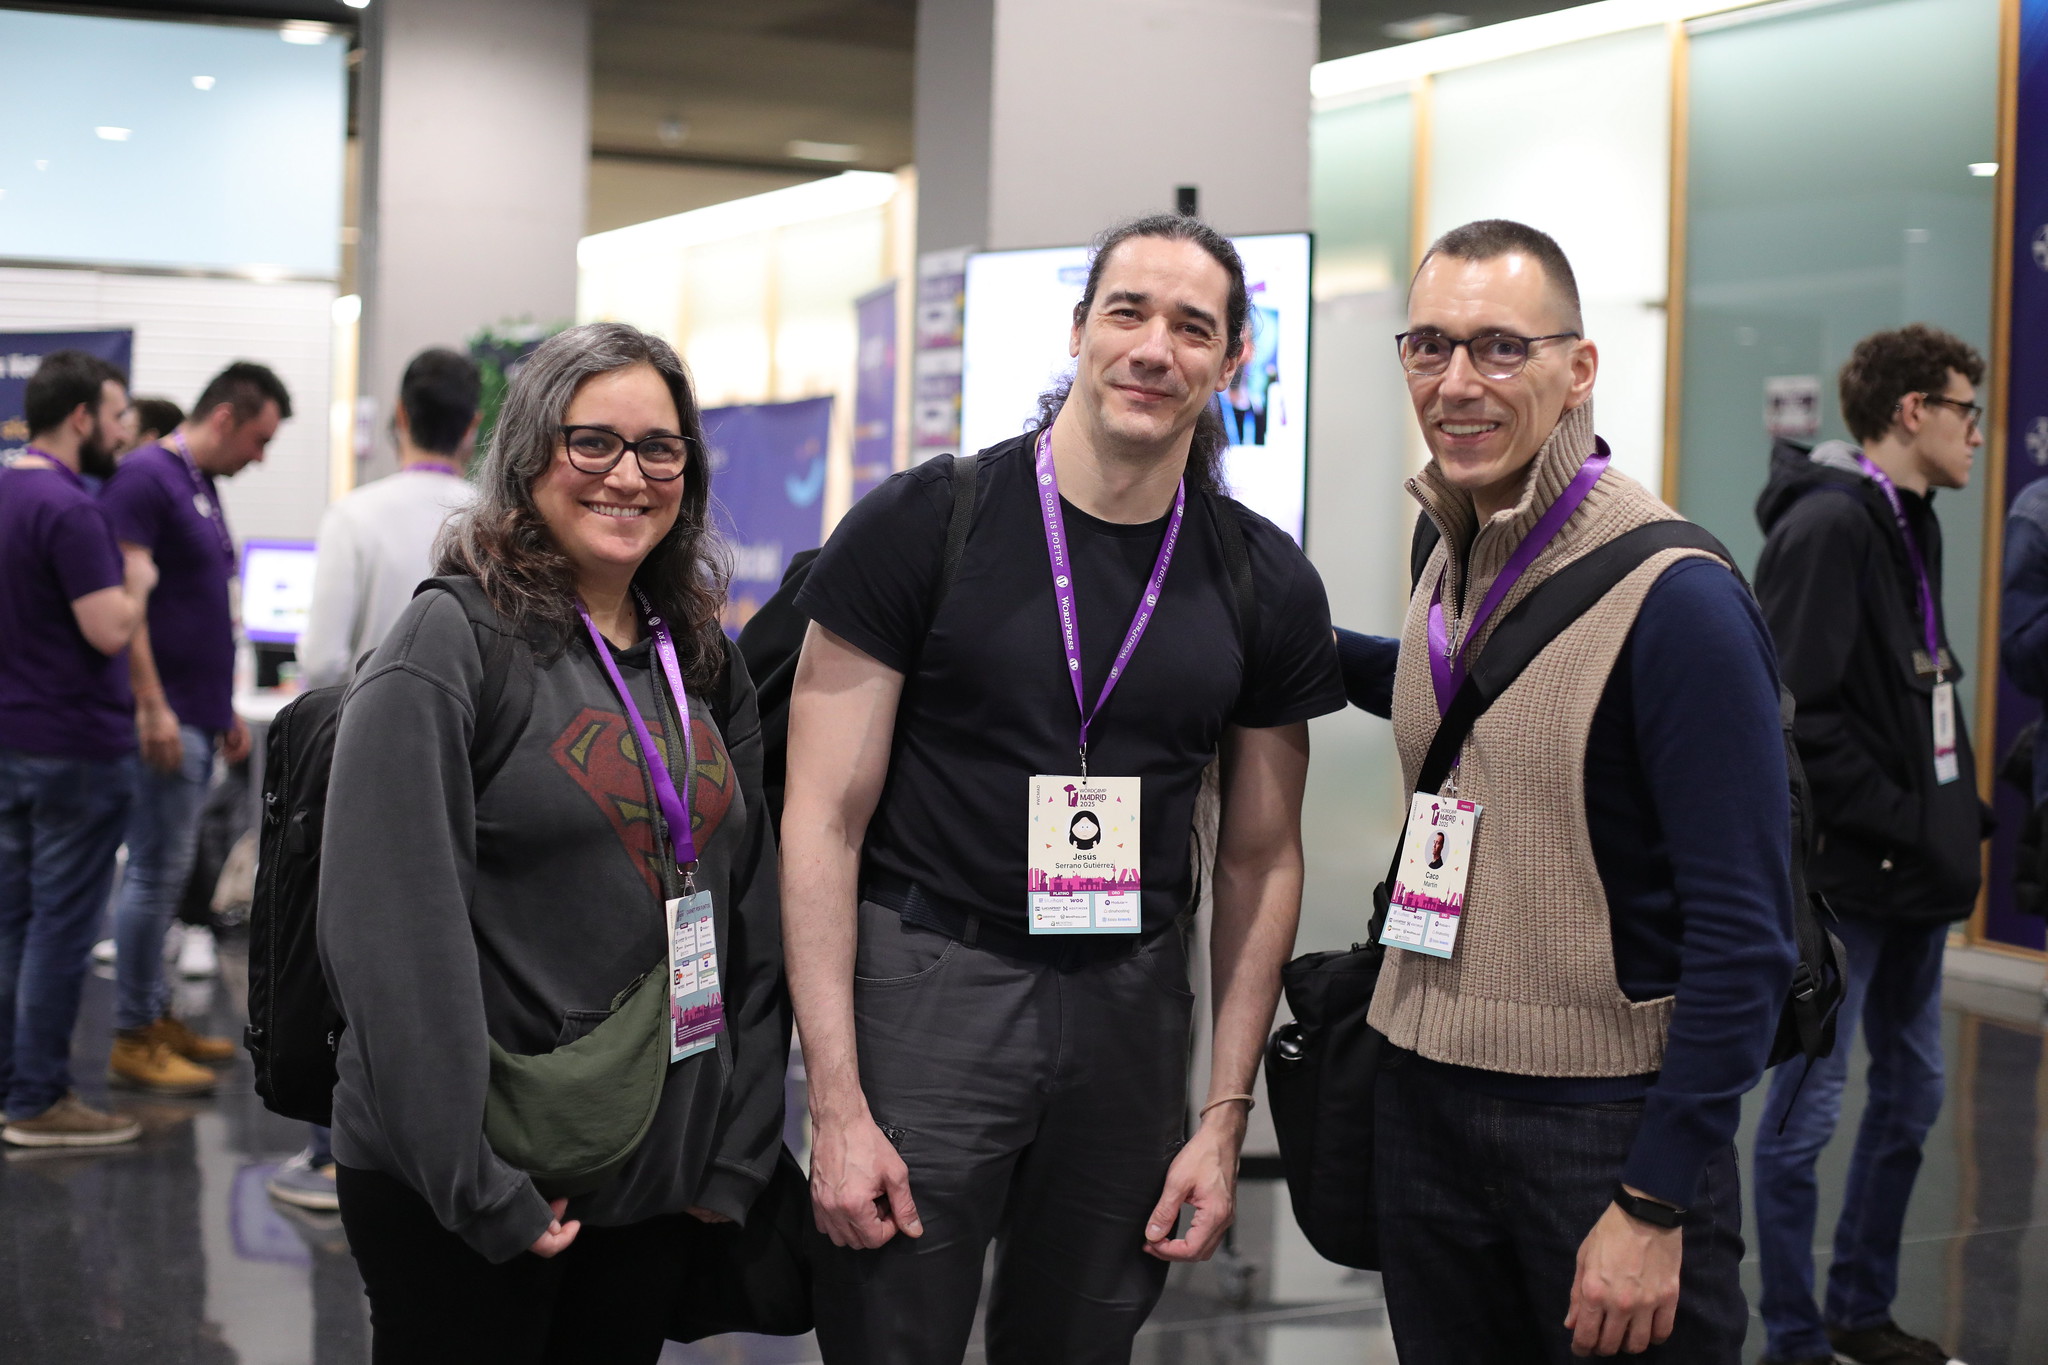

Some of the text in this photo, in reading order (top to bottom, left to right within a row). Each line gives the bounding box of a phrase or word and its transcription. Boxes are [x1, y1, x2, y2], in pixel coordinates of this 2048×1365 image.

[1045, 492, 1064, 567] CODE IS POETRY
[1155, 521, 1179, 589] CODE IS POETRY
[656, 630, 672, 661] POETRY
[1080, 794, 1107, 803] MADRID
[1073, 852, 1097, 861] Jesús
[1425, 871, 1440, 880] Caco
